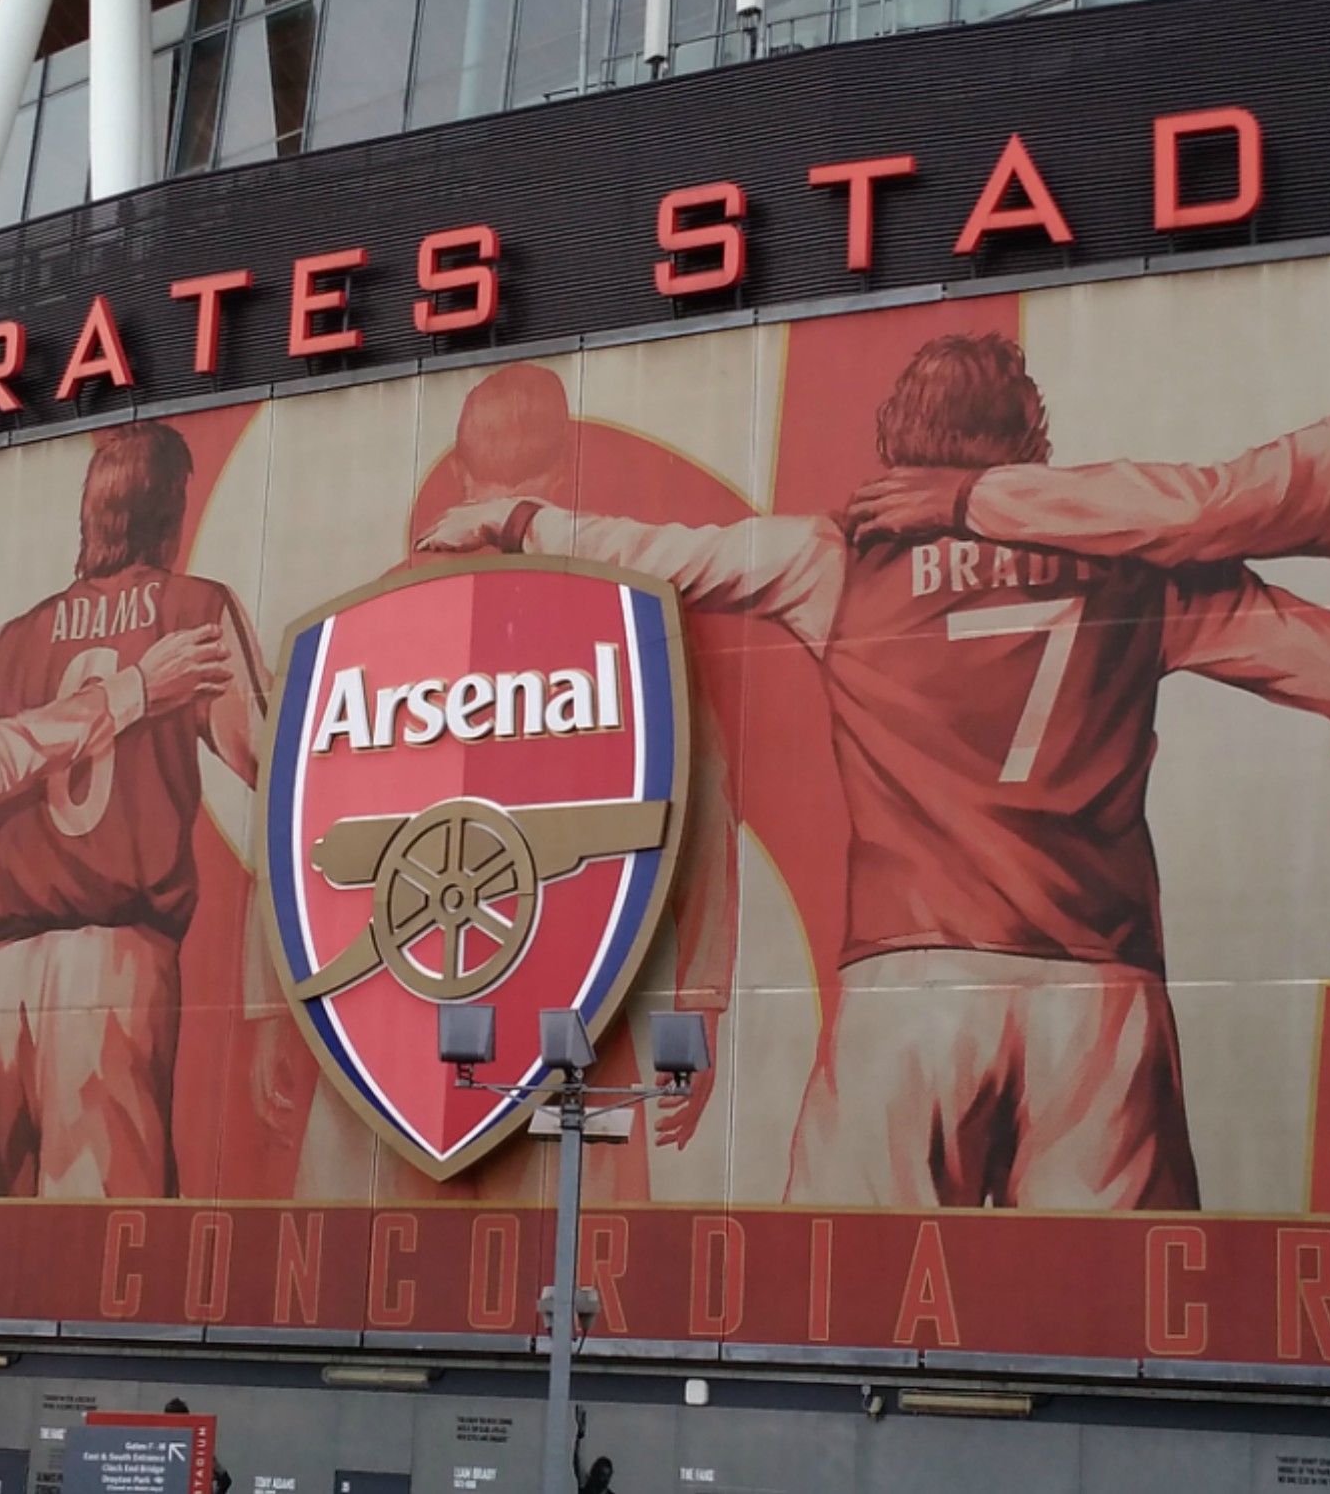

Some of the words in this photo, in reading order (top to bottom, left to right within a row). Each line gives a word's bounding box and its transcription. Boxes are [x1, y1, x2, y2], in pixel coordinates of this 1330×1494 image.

[49, 580, 160, 647] ADAMS
[311, 642, 624, 757] Arsenal
[947, 597, 1085, 782] 7
[99, 1209, 961, 1346] CONCORDIA
[83, 1452, 98, 1461] East
[101, 1452, 107, 1461] &
[109, 1452, 131, 1462] South
[133, 1453, 165, 1462] Entrance
[125, 1442, 146, 1451] Gates
[101, 1474, 131, 1485] Drayton
[133, 1475, 150, 1484] Park
[102, 1464, 121, 1473] Clock
[125, 1464, 138, 1473] End
[140, 1464, 164, 1474] Bridge
